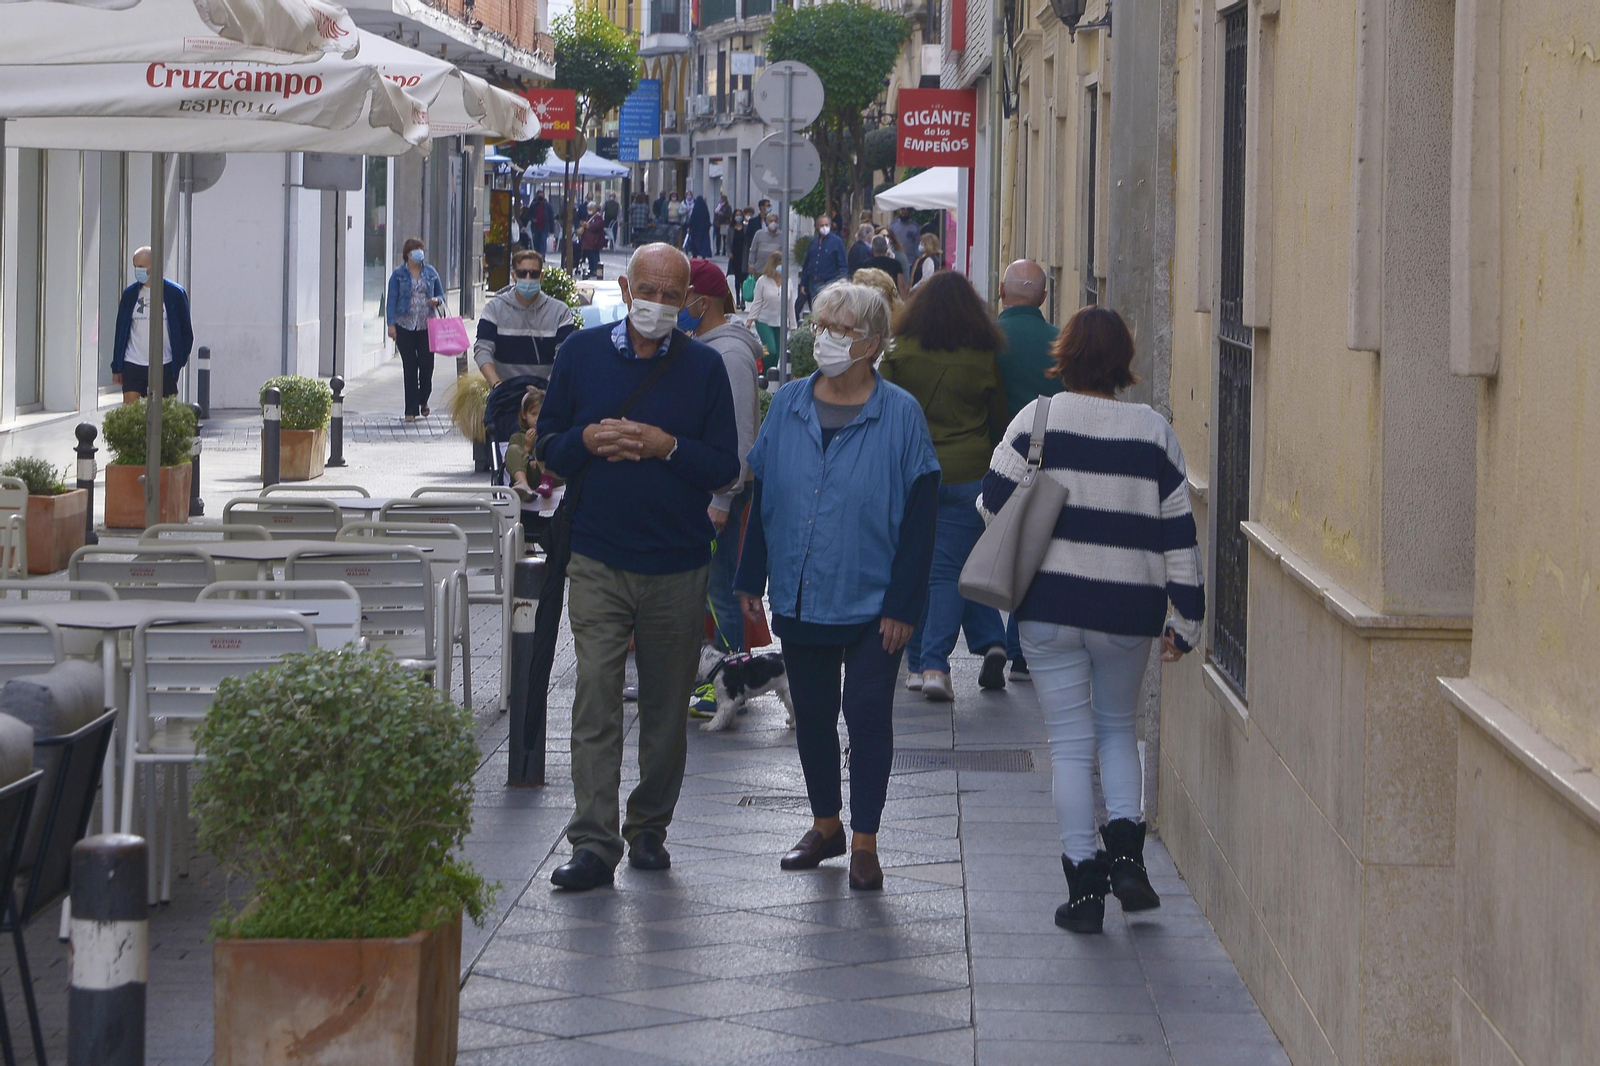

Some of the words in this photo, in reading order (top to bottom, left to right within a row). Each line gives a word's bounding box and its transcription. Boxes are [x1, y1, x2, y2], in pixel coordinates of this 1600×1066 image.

[146, 62, 322, 99] Cruzcampo
[903, 110, 971, 127] GIGANTE
[924, 127, 936, 136] de
[937, 127, 951, 136] los
[903, 137, 969, 153] EMPEÑOS
